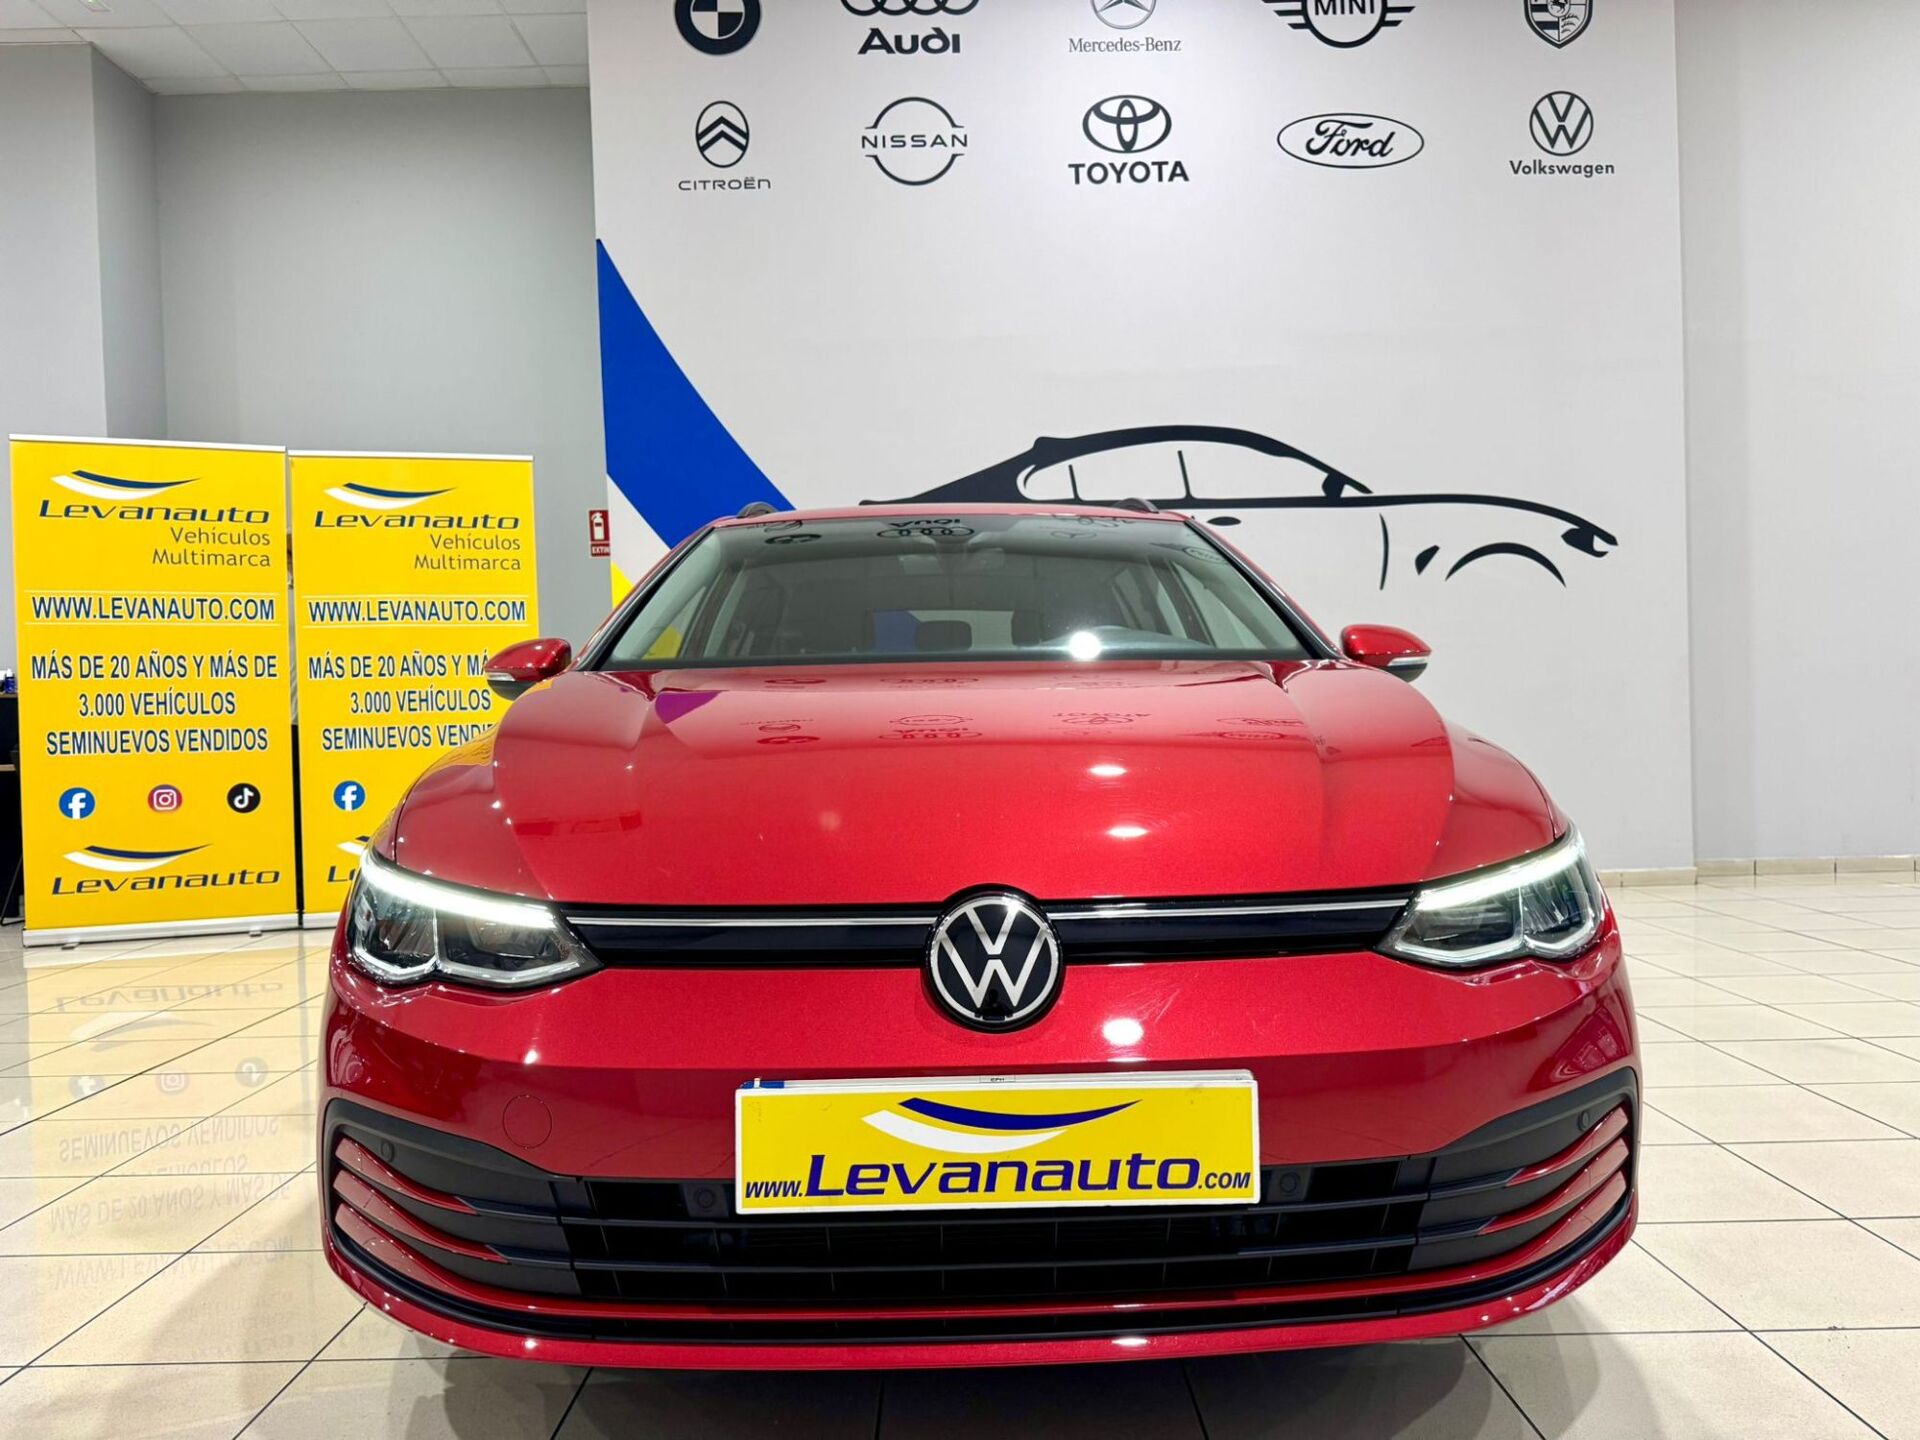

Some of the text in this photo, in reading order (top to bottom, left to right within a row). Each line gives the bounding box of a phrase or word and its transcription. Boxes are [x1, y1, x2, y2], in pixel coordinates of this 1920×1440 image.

[1315, 0, 1374, 16] MINI
[857, 27, 961, 55] Audi
[1068, 36, 1182, 53] Mercedes-Benz
[861, 134, 968, 149] NISSAN
[1305, 119, 1396, 158] Ford
[1067, 160, 1190, 185] TOYOTA
[1509, 159, 1615, 178] Volkswagen
[39, 499, 270, 524] Levanauto
[314, 510, 519, 529] Levanauto
[170, 527, 271, 546] Vehículos
[430, 533, 521, 551] Vehículos
[152, 549, 271, 567] Multimarca
[414, 554, 521, 571] Multimarca
[32, 596, 274, 620] WWW.LEVANAUTO.COM
[308, 600, 525, 622] WWW.LEVANAUTO.COM
[31, 650, 278, 679] MÁS DE 20 AÑOS Y MÁS DE
[308, 650, 488, 679] MÁS DE 20 AÑOS Y MÁ
[79, 687, 236, 717] 3.000 VEHÍCULOS
[350, 685, 492, 714] 3.000 VEHÍCULOS
[46, 727, 268, 756] SEMINUEVOS VENDIDOS
[322, 725, 432, 751] SEMINUEVOS
[52, 869, 280, 895] Levanauto
